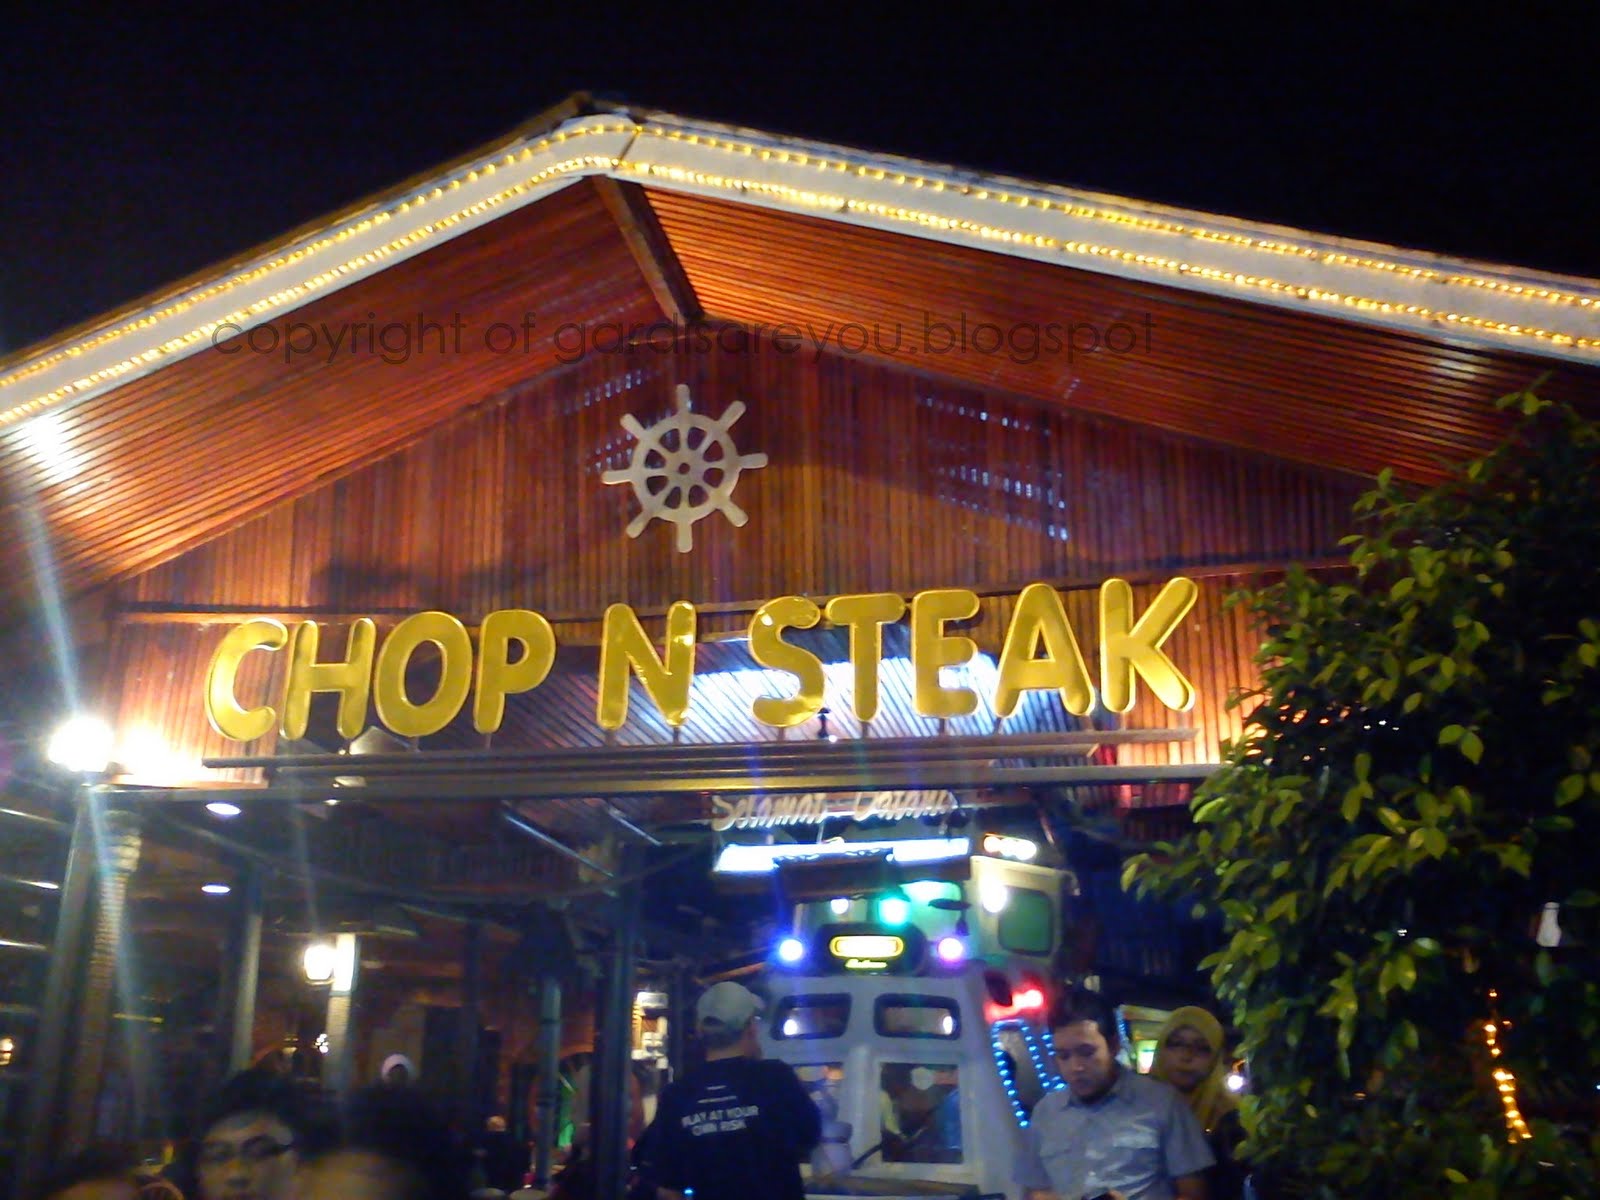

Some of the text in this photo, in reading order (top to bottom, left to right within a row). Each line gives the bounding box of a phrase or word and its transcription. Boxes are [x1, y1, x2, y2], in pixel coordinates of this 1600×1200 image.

[205, 576, 1199, 741] CHOP N STEAK
